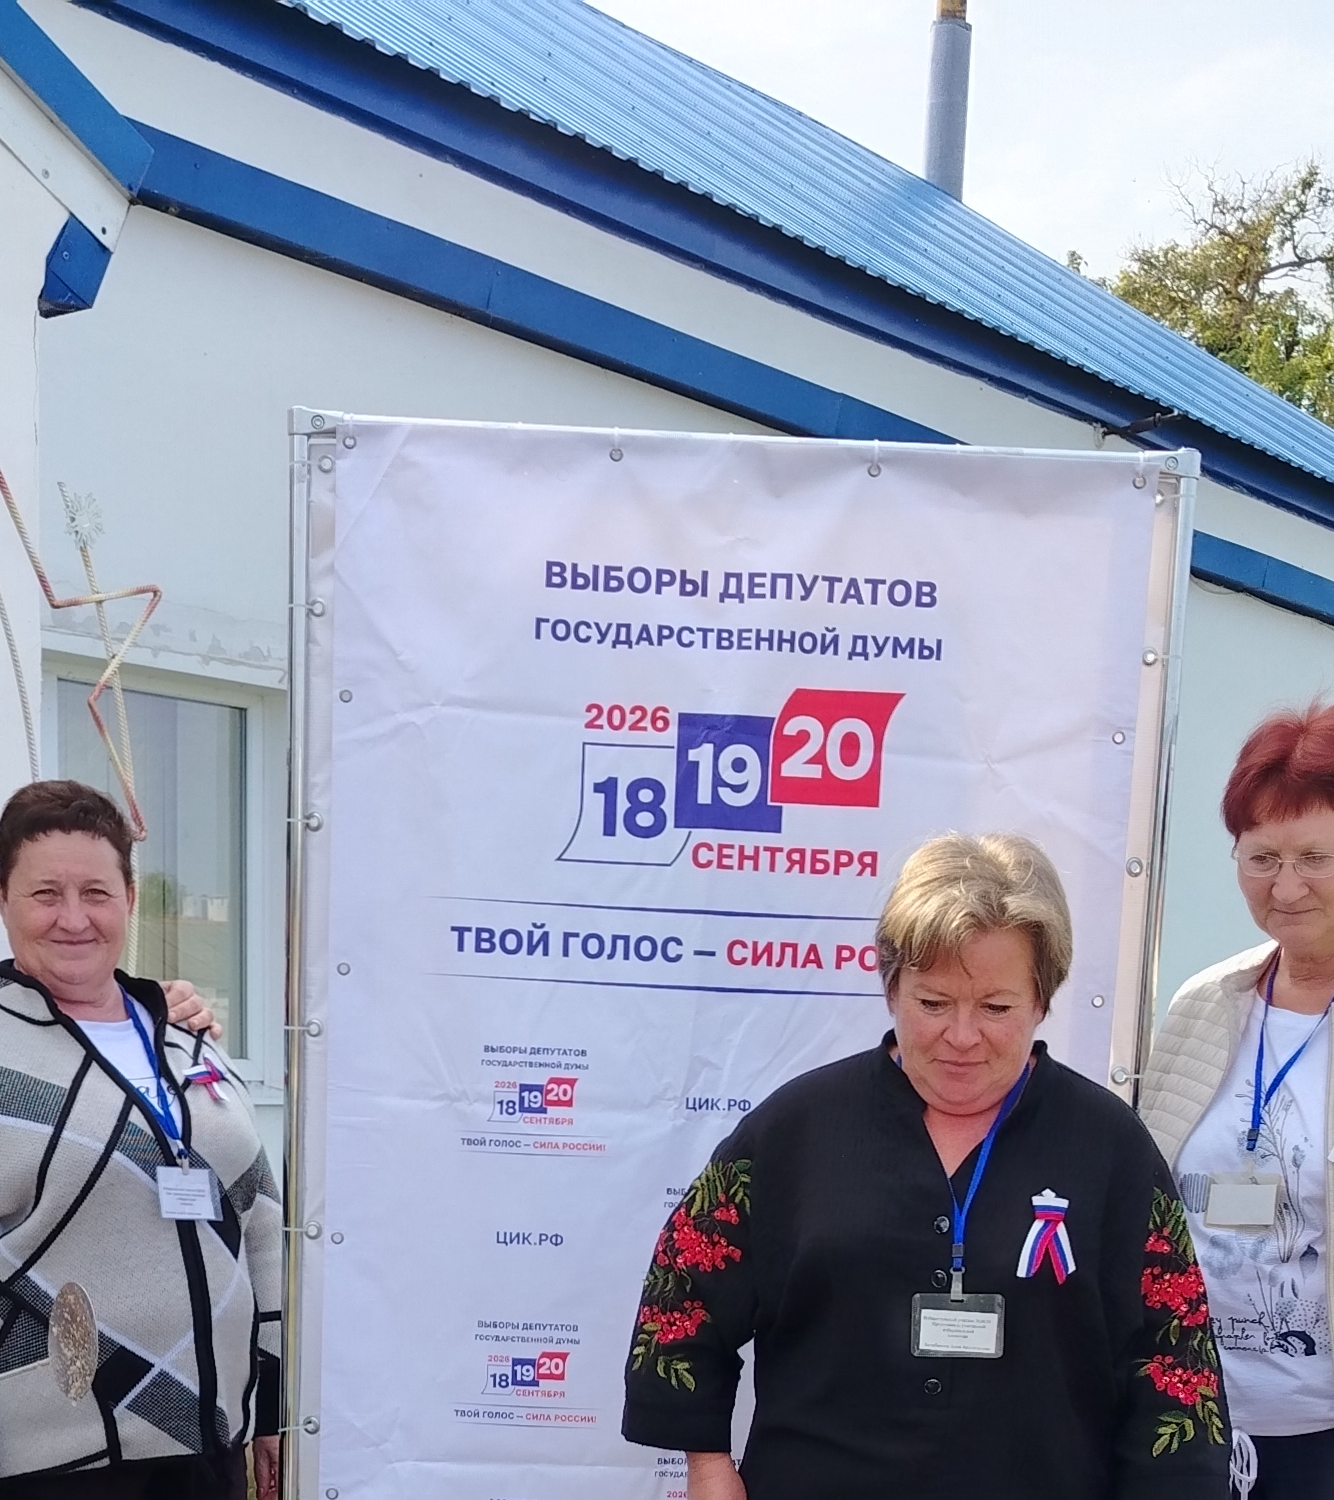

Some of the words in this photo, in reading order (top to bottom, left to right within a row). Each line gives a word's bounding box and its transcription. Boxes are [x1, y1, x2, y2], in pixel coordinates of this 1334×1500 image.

[544, 560, 708, 599] ВЫБОРЫ
[718, 571, 937, 609] ДЕПУТАТОВ
[535, 617, 840, 658] ГОСУДАРСТВЕННОЙ
[849, 634, 942, 662] ДУМЫ
[583, 703, 670, 733] 2026
[592, 775, 667, 839] 18
[688, 743, 762, 807] 19
[780, 715, 873, 779] 20
[691, 841, 879, 878] СЕНТЯБРЯ
[450, 921, 551, 960] ТВОЙ
[561, 930, 683, 964] ГОЛОС
[726, 938, 824, 972] СИЛА
[483, 1045, 527, 1054] ВЫБОРЫ
[529, 1047, 587, 1057] ДЕПУТАТОВ
[481, 1059, 562, 1069] ГОСУДАРСТВЕННОЙ
[494, 1081, 517, 1089] 2026
[497, 1100, 517, 1115] 18
[521, 1091, 541, 1108] 19
[546, 1084, 572, 1101] 20
[686, 1098, 751, 1112] ЦИК.РФ
[523, 1116, 573, 1125] СЕНТЯБРЯ
[460, 1137, 486, 1146] ТВОЙ
[489, 1139, 521, 1148] ГОЛОС
[533, 1141, 560, 1150] СИЛА
[496, 1232, 563, 1247] ЦИК.РФ
[477, 1320, 519, 1329] ВЫБОРЫ
[522, 1322, 578, 1332] ДЕПУТАТОВ
[490, 1373, 509, 1388] 18
[514, 1365, 534, 1381] 19
[538, 1357, 563, 1374] 20
[516, 1390, 565, 1398] СЕНТЯБРЯ
[454, 1409, 480, 1418] ТВОЙ
[482, 1410, 514, 1420] ГОЛОС
[525, 1413, 552, 1421] СИЛА
